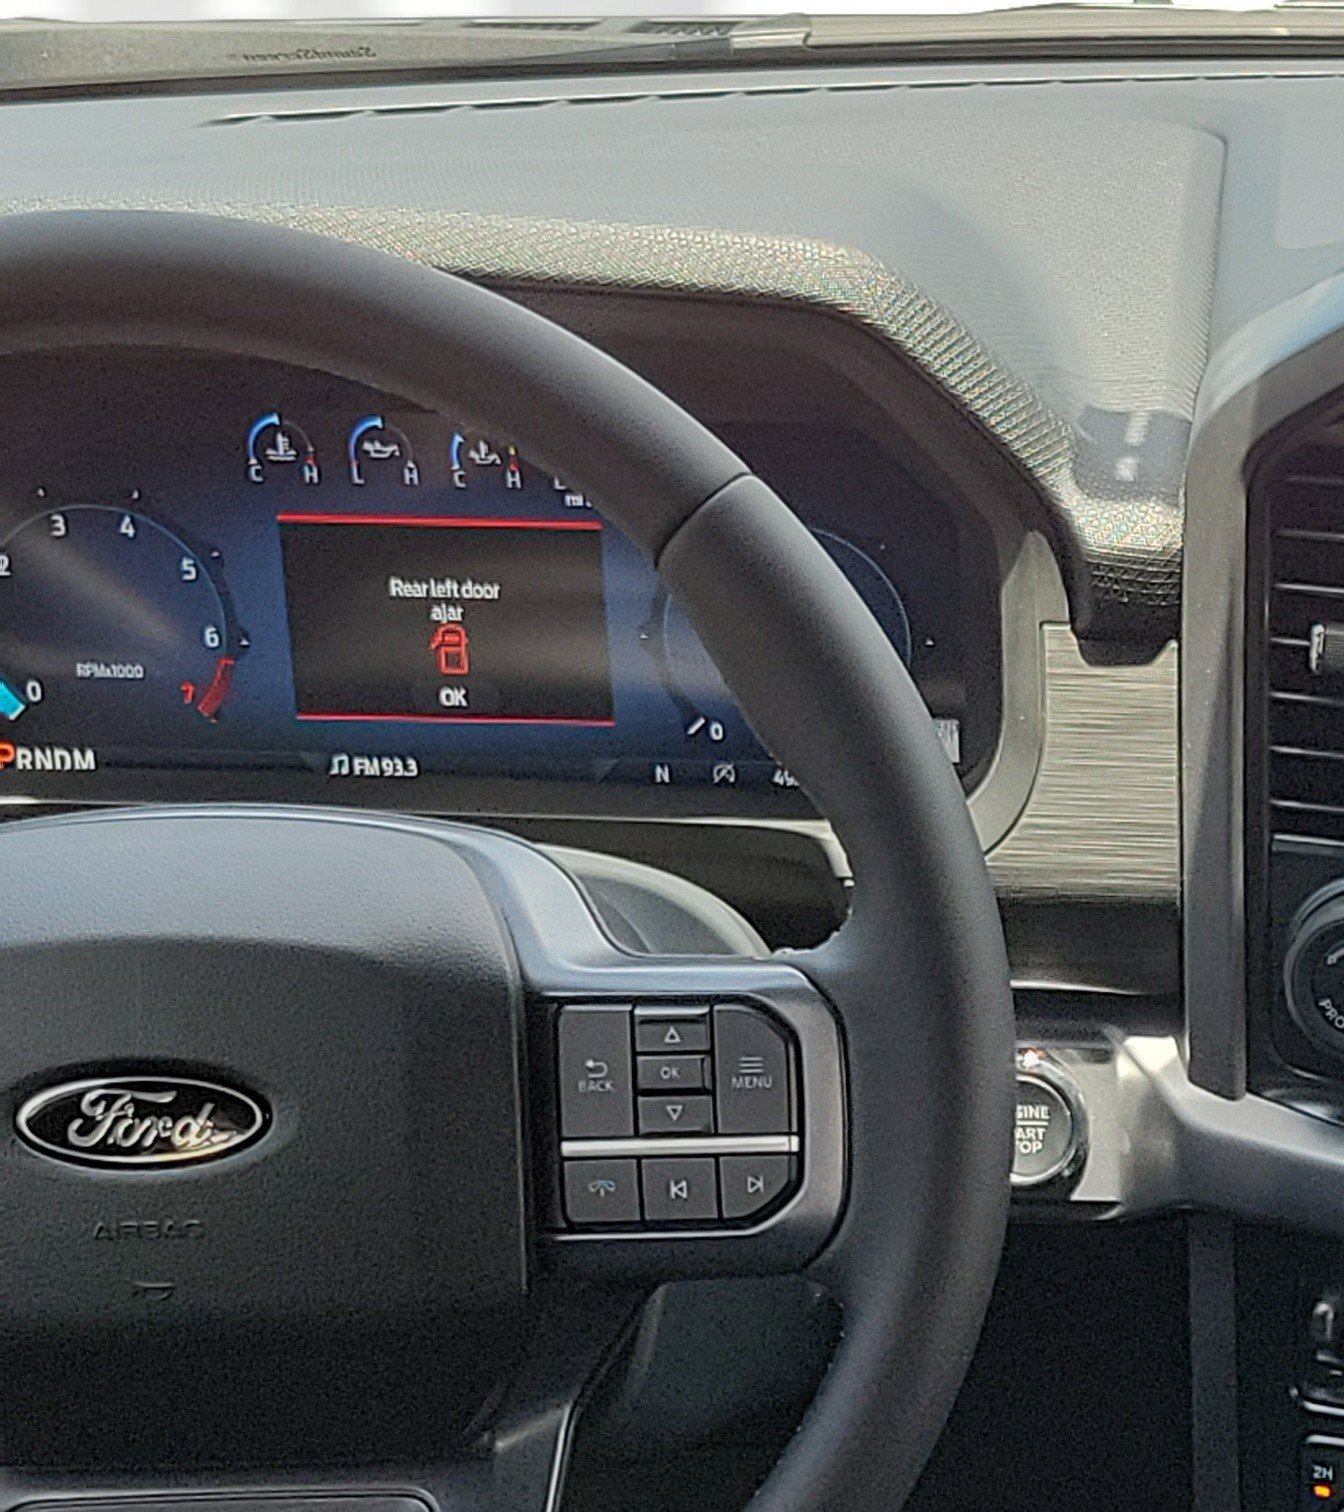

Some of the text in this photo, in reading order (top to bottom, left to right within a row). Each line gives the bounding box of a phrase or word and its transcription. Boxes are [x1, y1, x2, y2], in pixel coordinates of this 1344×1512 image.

[250, 464, 264, 482] C
[303, 464, 320, 485] H
[353, 464, 365, 485] L
[404, 466, 420, 486] H
[454, 470, 467, 489] C
[506, 471, 522, 490] H
[51, 515, 67, 537] 3
[119, 515, 136, 538] 4
[182, 557, 197, 581] 5
[389, 575, 500, 600] Rear left door
[430, 603, 464, 624] ajar
[204, 627, 220, 648] 6
[26, 680, 42, 702] 0
[439, 685, 468, 707] OK
[708, 721, 724, 741] 0
[353, 757, 380, 776] FM
[654, 765, 671, 784] N
[659, 1065, 681, 1080] OK
[577, 1080, 615, 1093] BACK
[731, 1076, 773, 1090] MENU
[67, 1089, 236, 1149] Ford
[1014, 1127, 1047, 1141] ART
[1313, 1466, 1334, 1481] 2H
